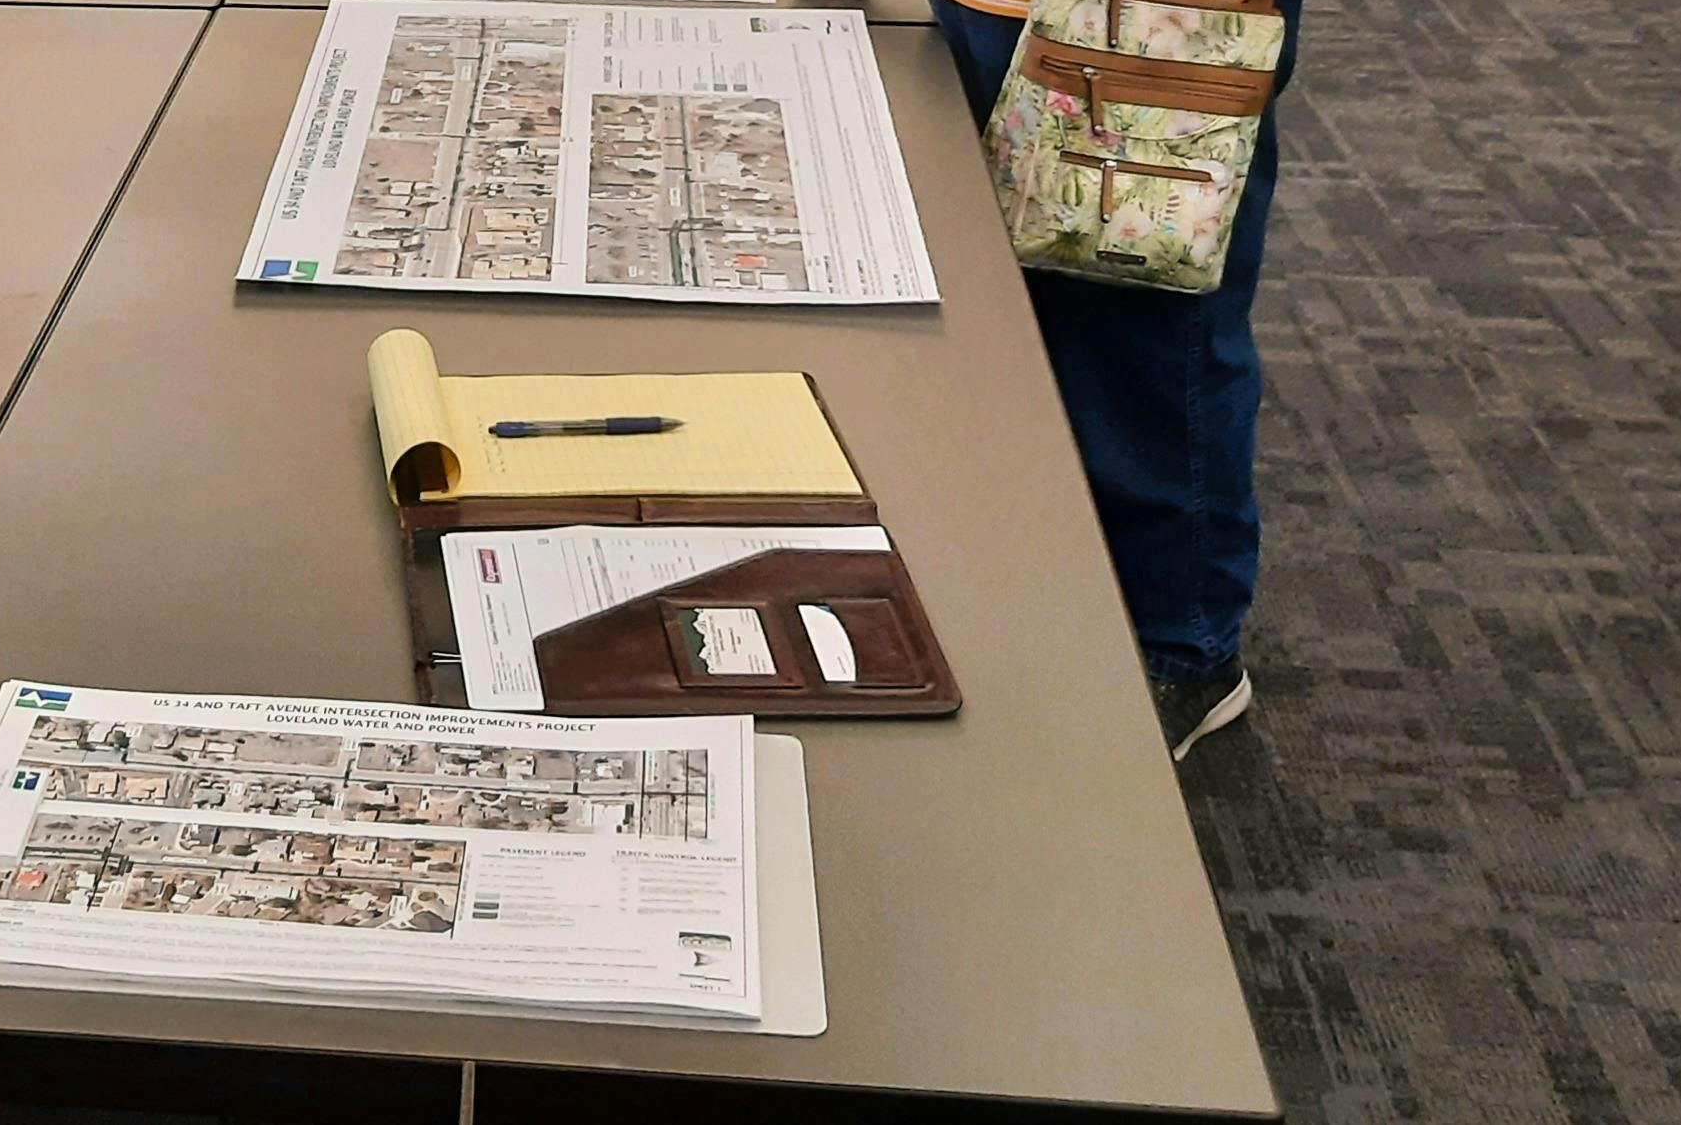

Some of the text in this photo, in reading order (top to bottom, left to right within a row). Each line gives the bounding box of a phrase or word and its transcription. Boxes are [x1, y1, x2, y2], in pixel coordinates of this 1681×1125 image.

[291, 171, 308, 186] TAFT
[288, 188, 305, 200] AND
[281, 210, 297, 220] US
[194, 701, 223, 709] AND
[228, 702, 262, 711] TAFT
[266, 704, 320, 714] AVENUE
[323, 707, 421, 720] INTERSECTION
[425, 714, 533, 729] IMPROVEMENTS
[537, 722, 597, 732] PROJECT
[267, 714, 476, 734] LOVELAND WATER AND POWER
